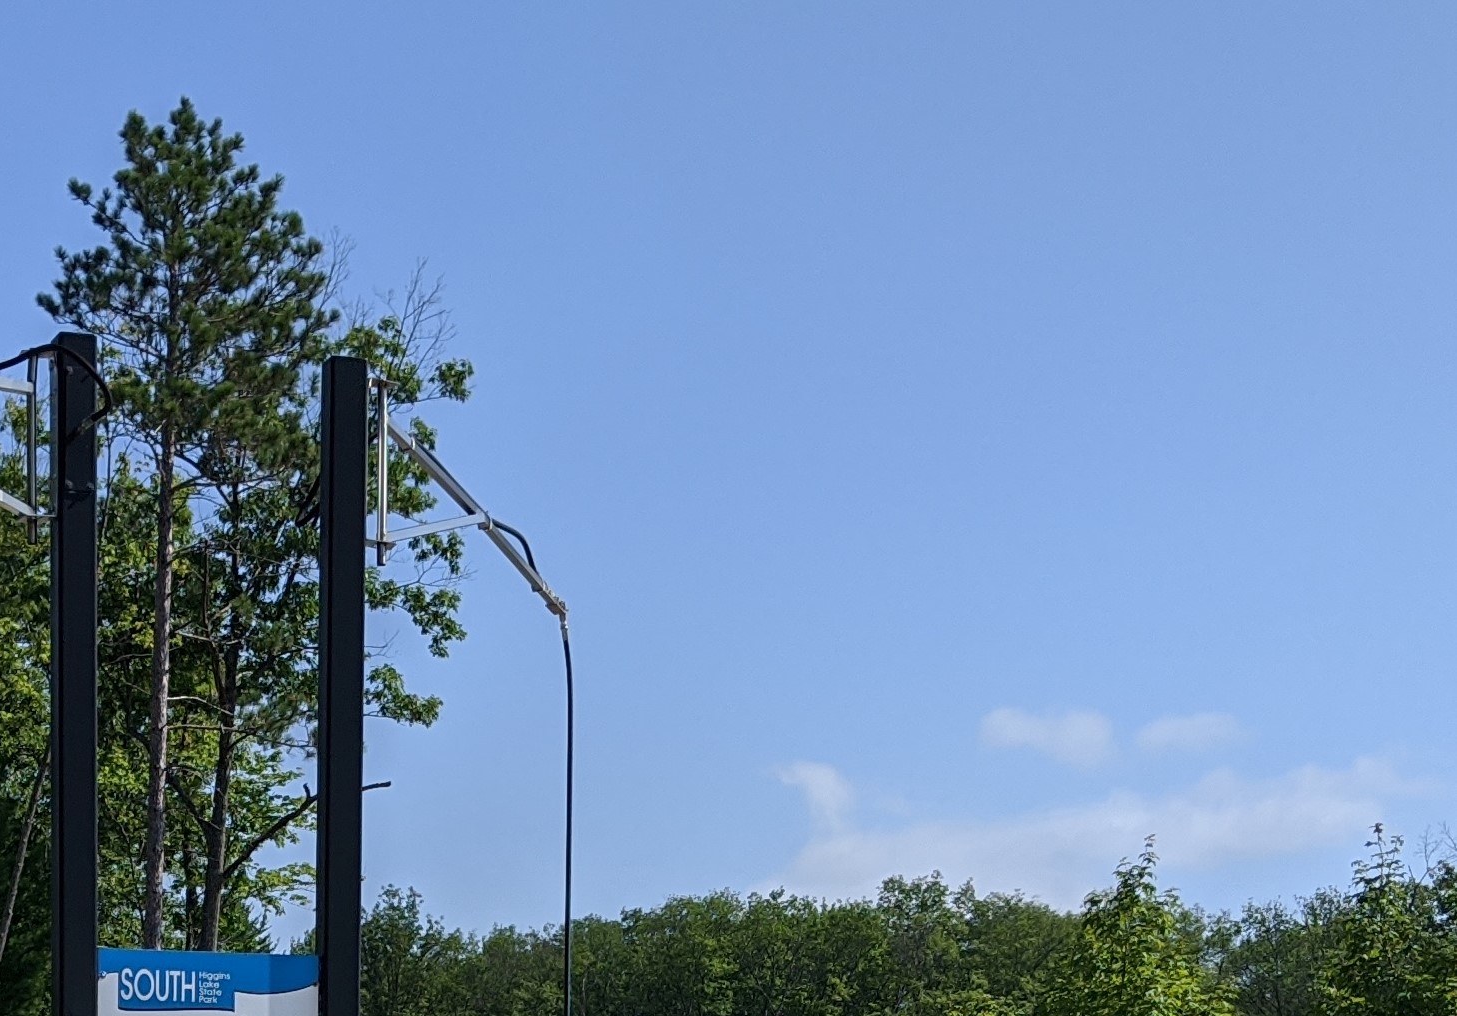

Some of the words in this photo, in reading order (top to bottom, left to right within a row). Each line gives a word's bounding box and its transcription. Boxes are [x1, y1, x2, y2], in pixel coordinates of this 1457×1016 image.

[198, 971, 230, 981] Higgins
[121, 968, 195, 1002] SOUTH
[198, 981, 219, 989] Lake
[198, 988, 222, 997] State
[198, 996, 218, 1004] Park
